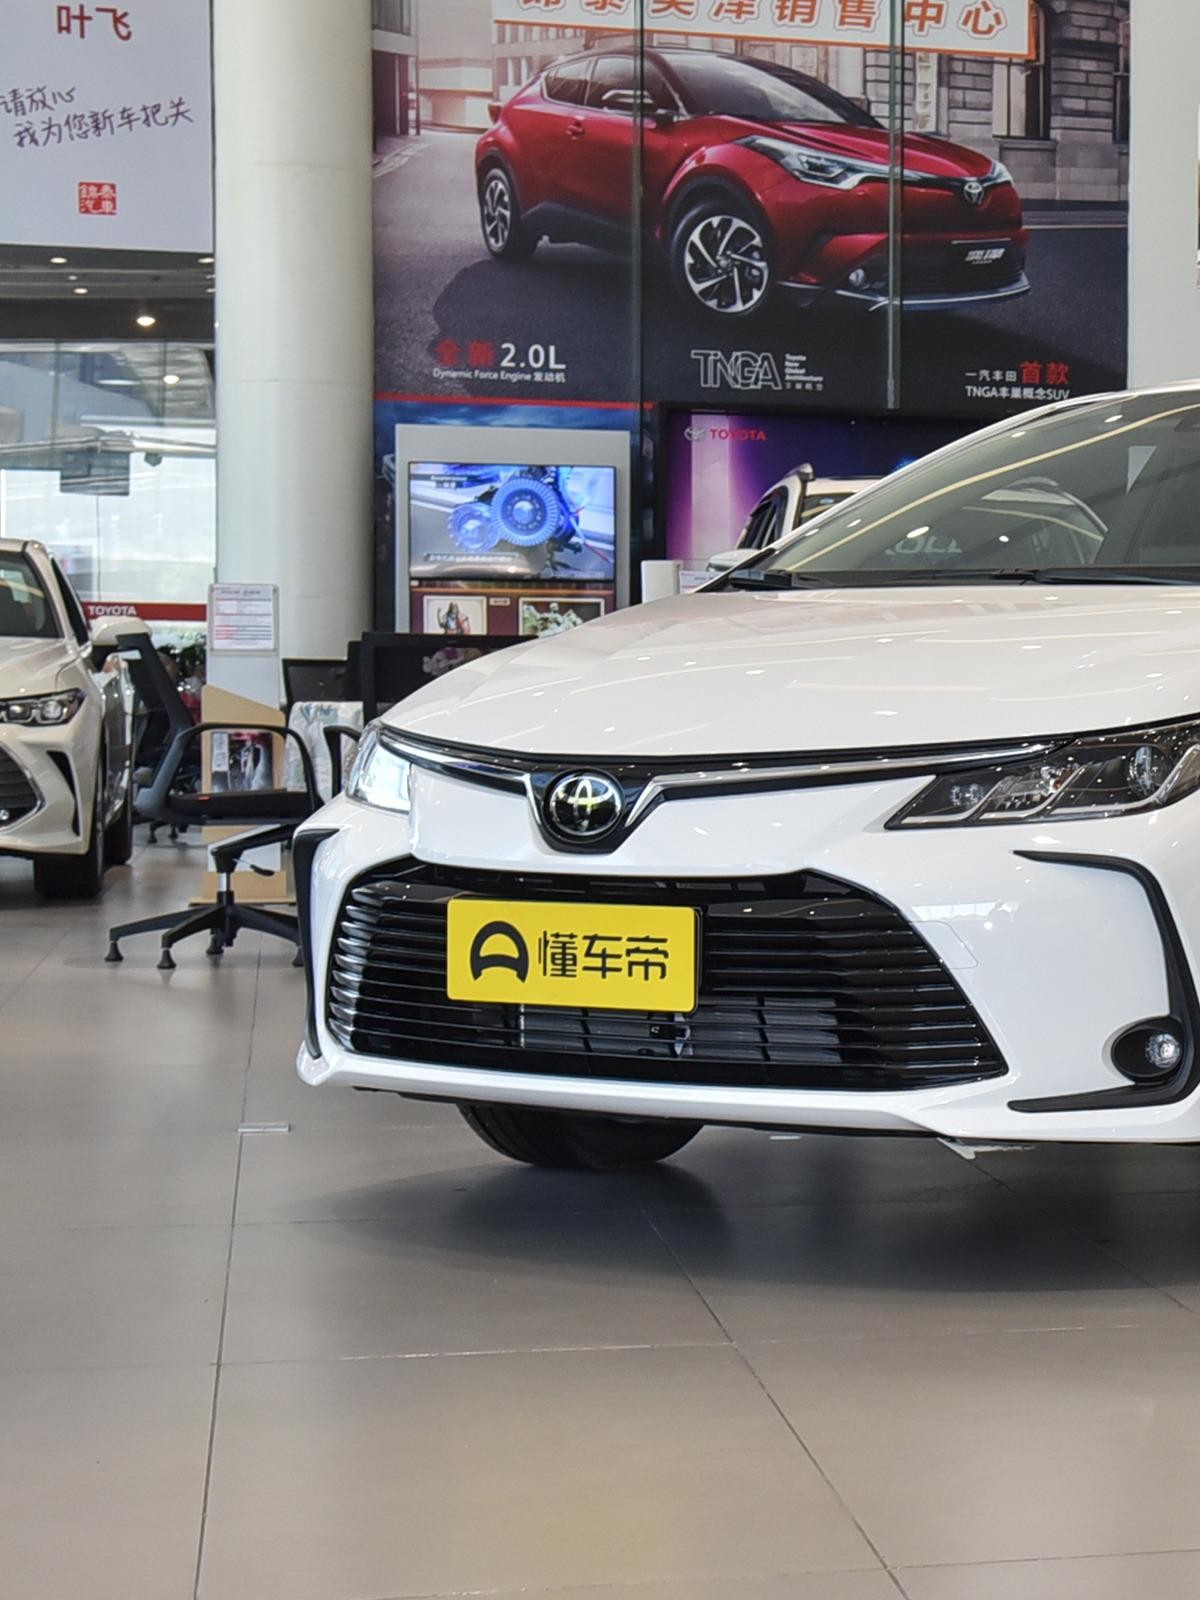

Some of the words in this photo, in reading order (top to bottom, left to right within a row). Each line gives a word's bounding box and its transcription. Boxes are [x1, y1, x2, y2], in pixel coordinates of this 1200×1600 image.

[57, 4, 132, 41] 叶飞
[0, 86, 76, 117] 请放心
[14, 97, 194, 148] 我为您新车把关
[691, 350, 783, 390] TNGA
[709, 428, 767, 441] TOYOTA
[88, 604, 137, 617] TOYOTA
[538, 930, 669, 982] 懂车帝
